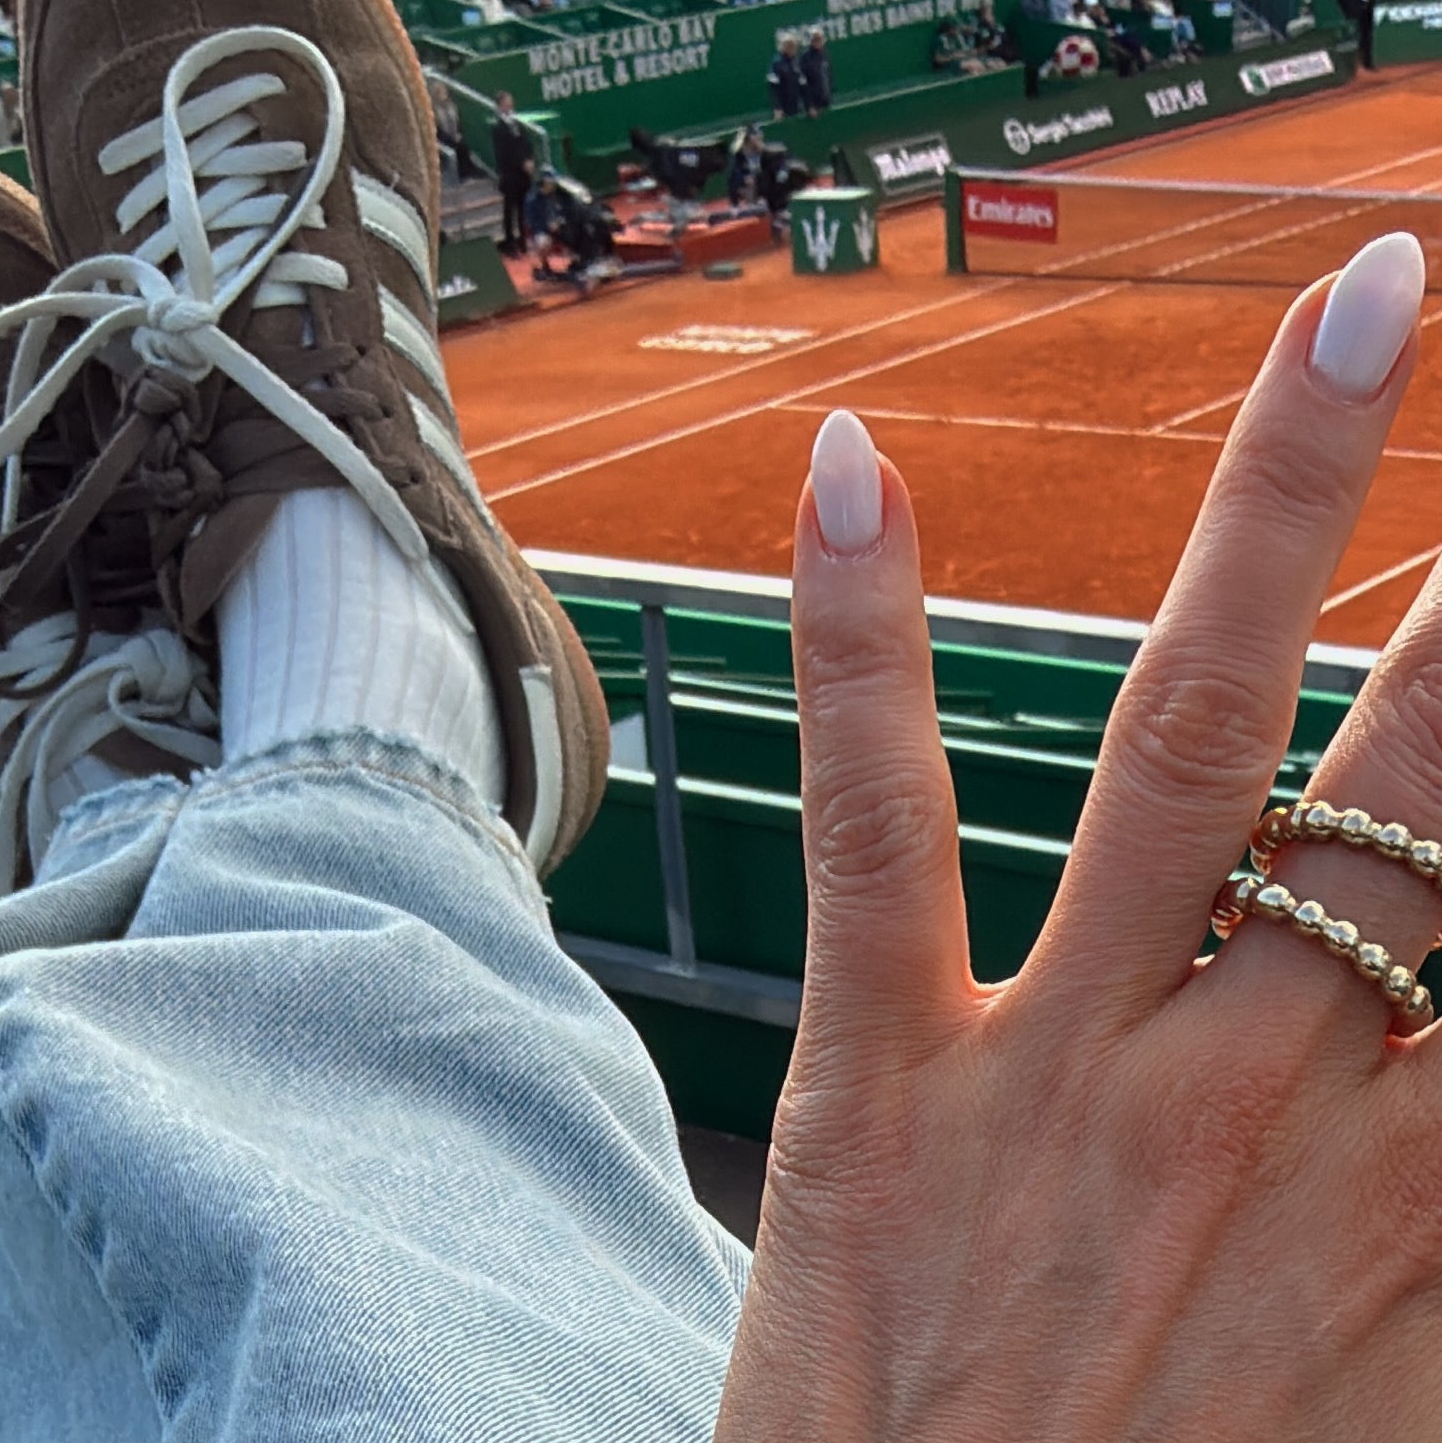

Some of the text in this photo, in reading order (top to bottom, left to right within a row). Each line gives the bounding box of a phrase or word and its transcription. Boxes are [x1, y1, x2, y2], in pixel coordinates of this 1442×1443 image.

[527, 13, 717, 75] MONTE-CARLO BAY
[541, 42, 710, 102] HOTEL & RESORT
[1145, 78, 1208, 119] REPLAY
[967, 194, 1054, 229] Emirates
